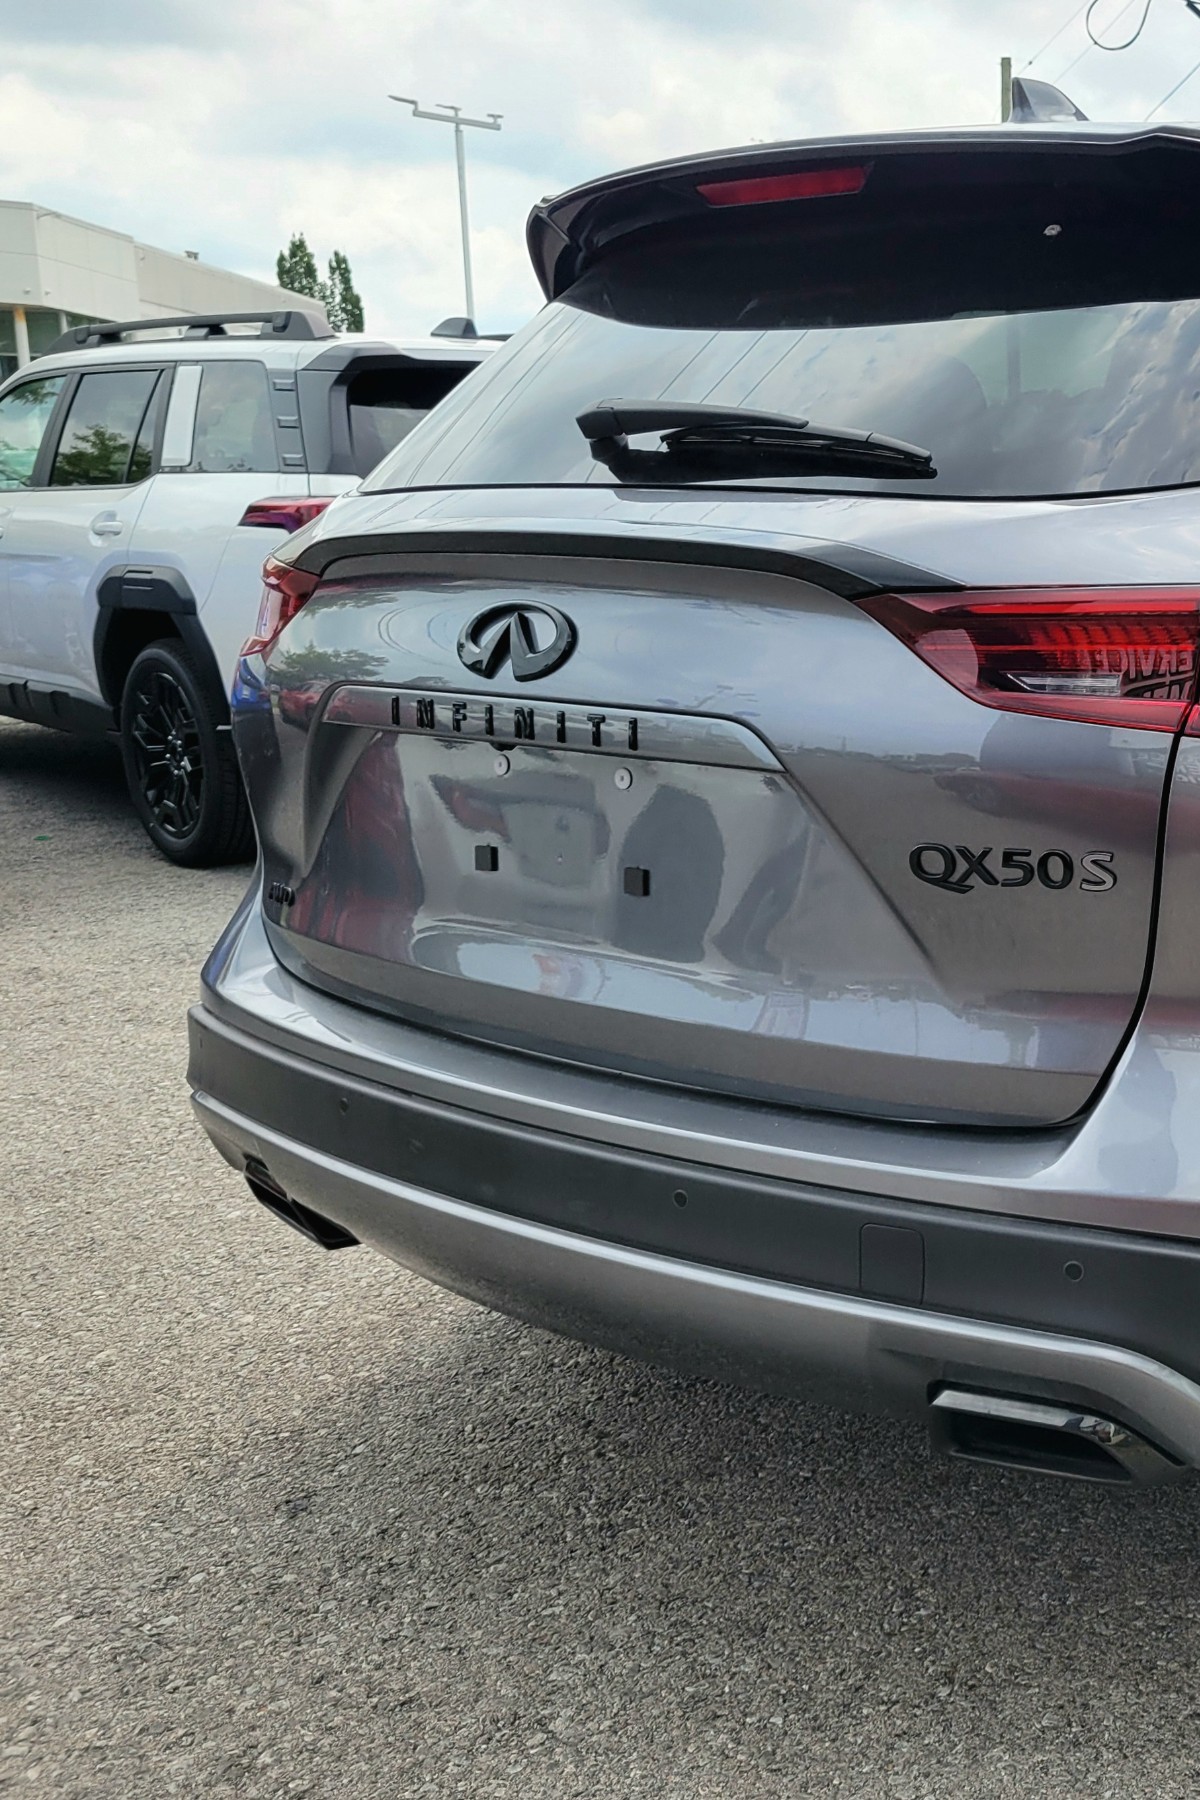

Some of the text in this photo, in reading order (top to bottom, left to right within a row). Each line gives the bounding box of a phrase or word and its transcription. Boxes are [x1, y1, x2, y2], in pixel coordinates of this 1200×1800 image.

[391, 695, 639, 751] INFINITI
[908, 842, 1118, 894] QX50 S
